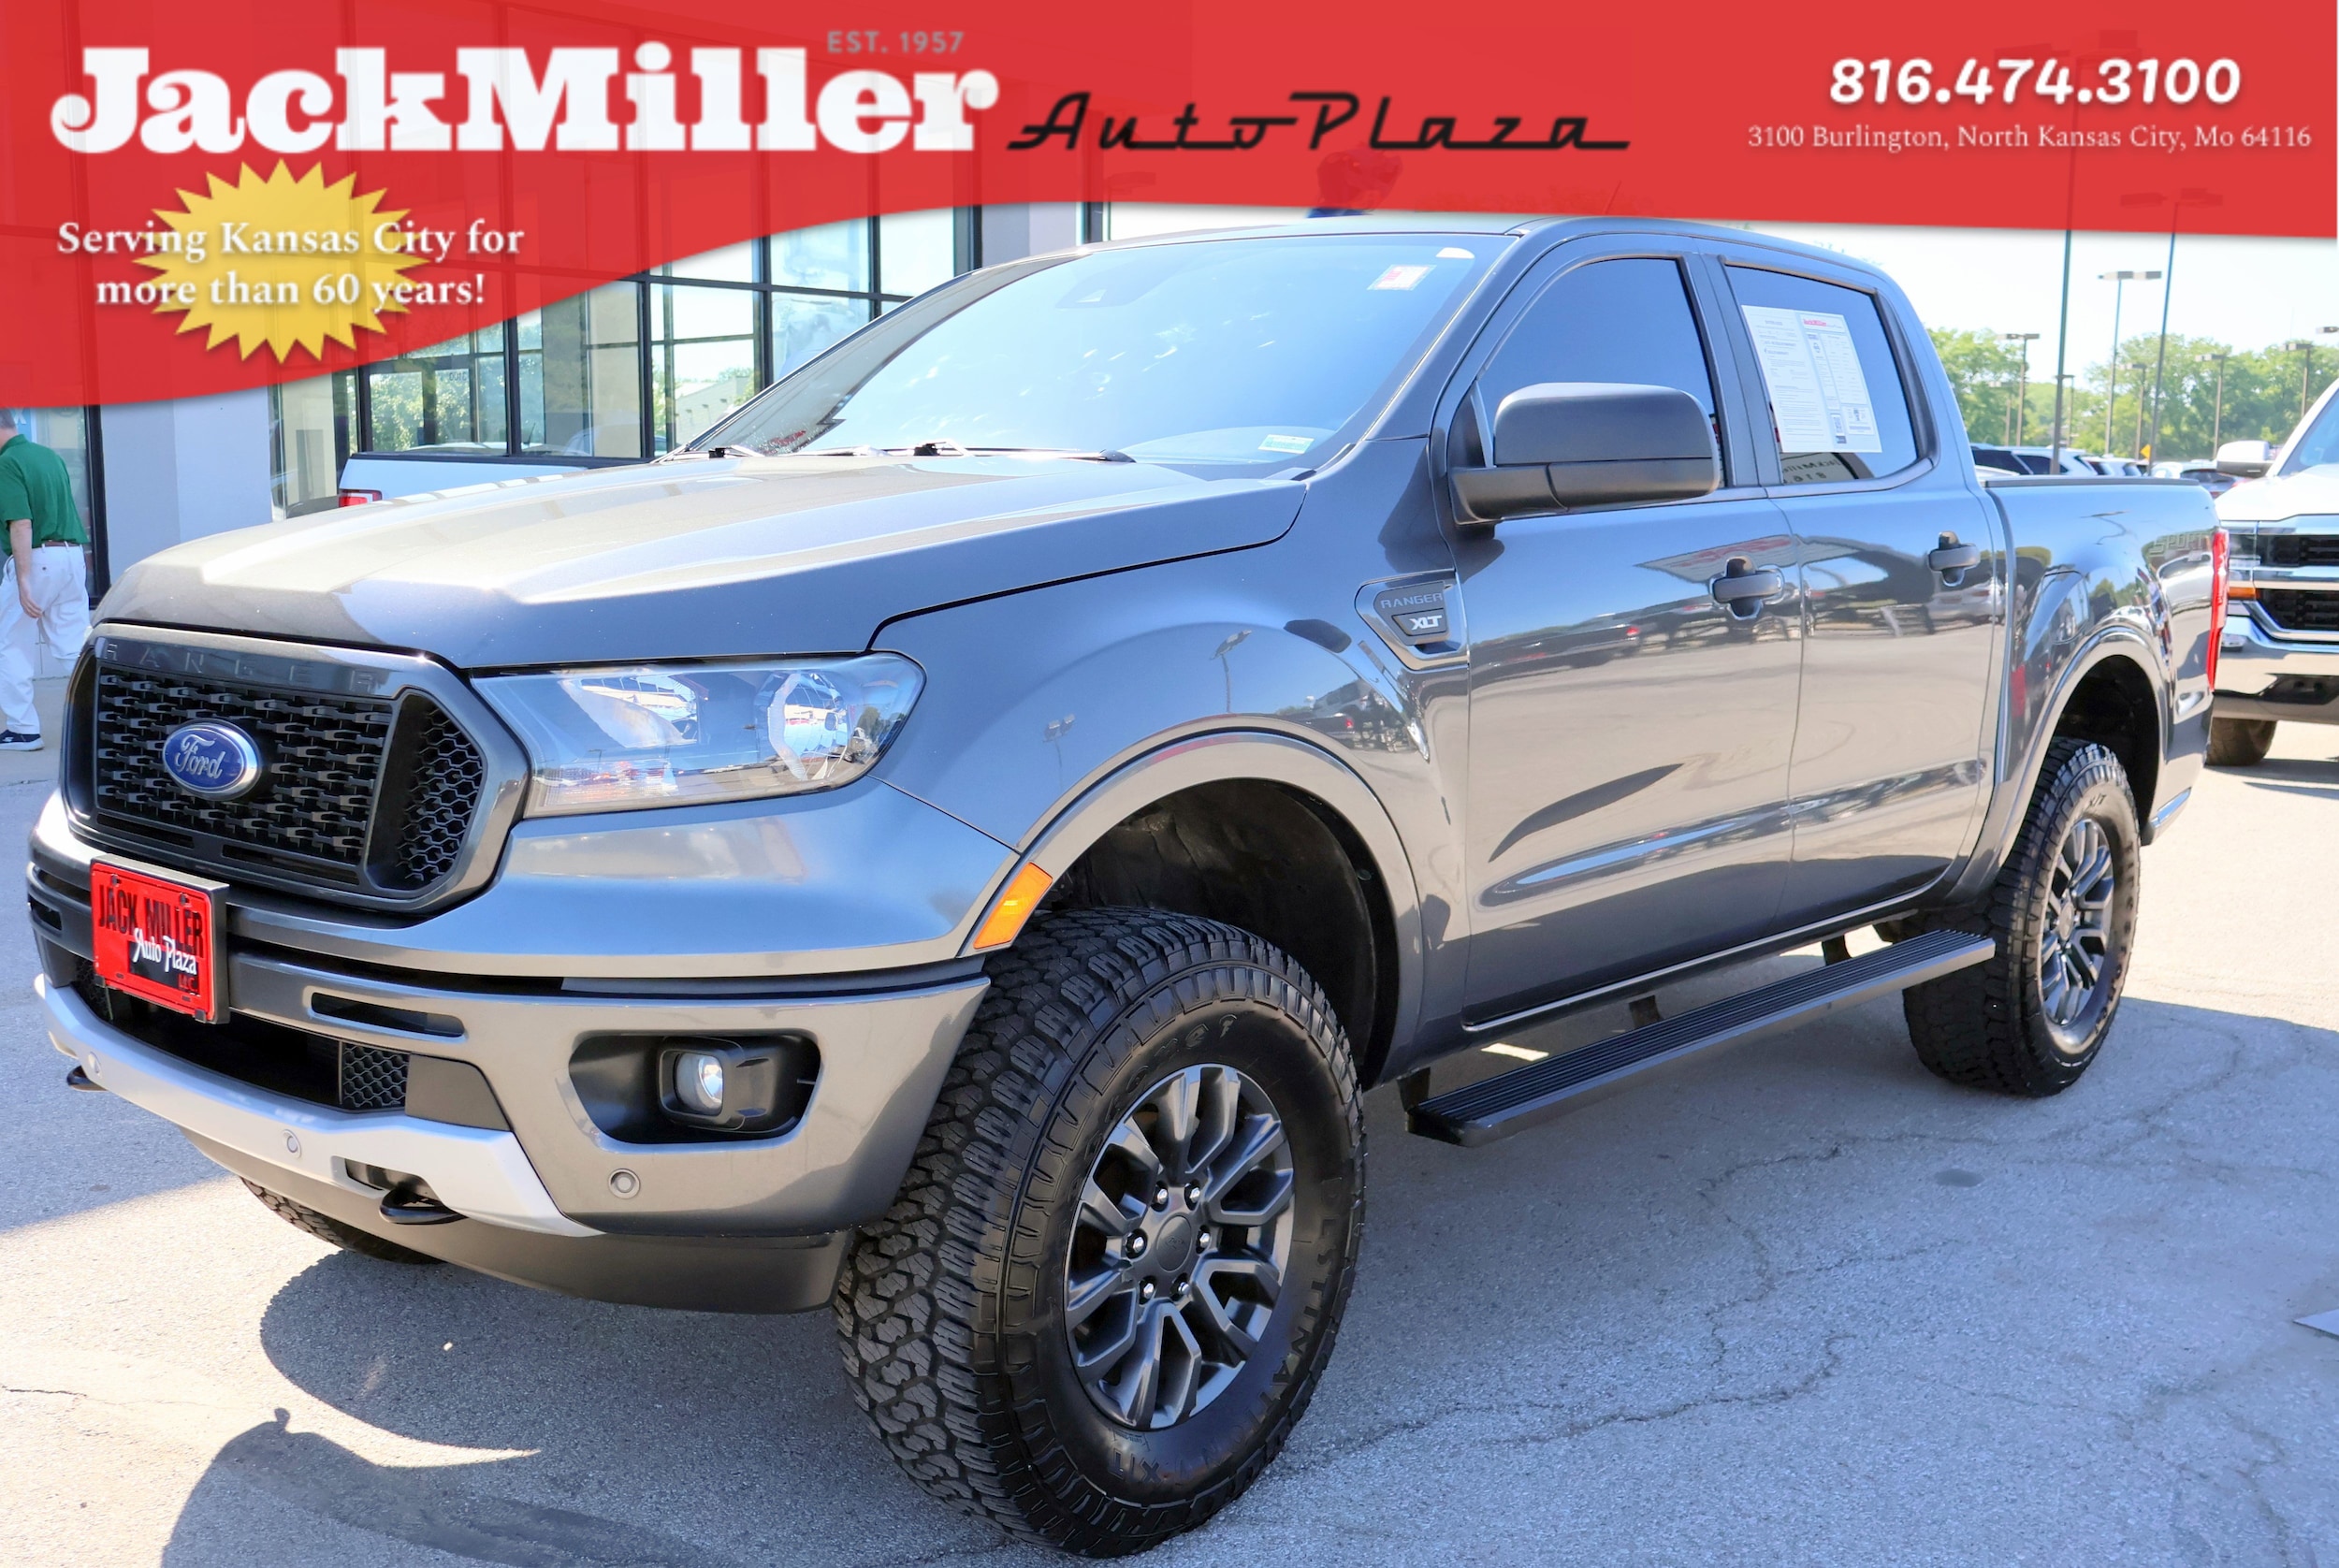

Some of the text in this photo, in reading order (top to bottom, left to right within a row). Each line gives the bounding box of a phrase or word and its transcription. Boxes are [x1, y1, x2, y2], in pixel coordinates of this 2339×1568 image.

[1380, 592, 1443, 608] RANGER
[1409, 615, 1443, 631] XLT
[104, 642, 373, 693] RANGER
[175, 733, 225, 779] Ford
[99, 884, 138, 936] JACK
[133, 927, 197, 975] Auto Plaza
